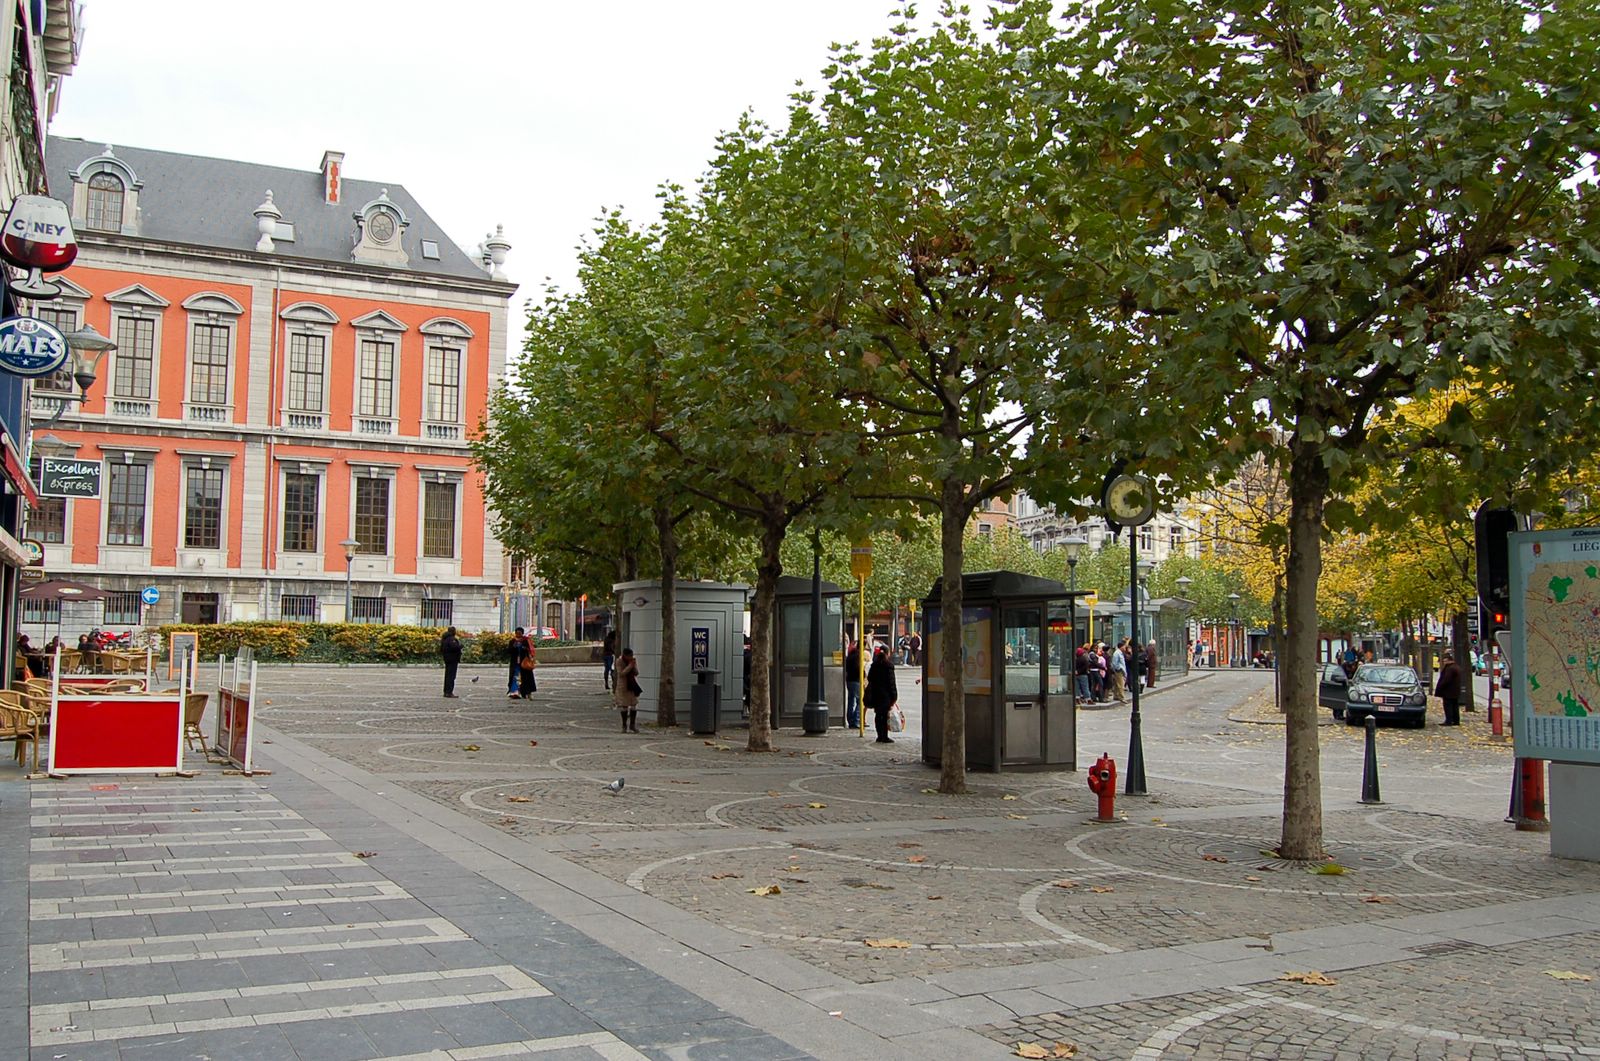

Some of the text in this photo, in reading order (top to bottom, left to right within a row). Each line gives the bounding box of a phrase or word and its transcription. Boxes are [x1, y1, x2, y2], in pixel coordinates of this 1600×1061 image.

[0, 333, 62, 358] MAES
[45, 460, 100, 476] Excellent
[50, 479, 94, 493] express
[694, 631, 707, 639] WC
